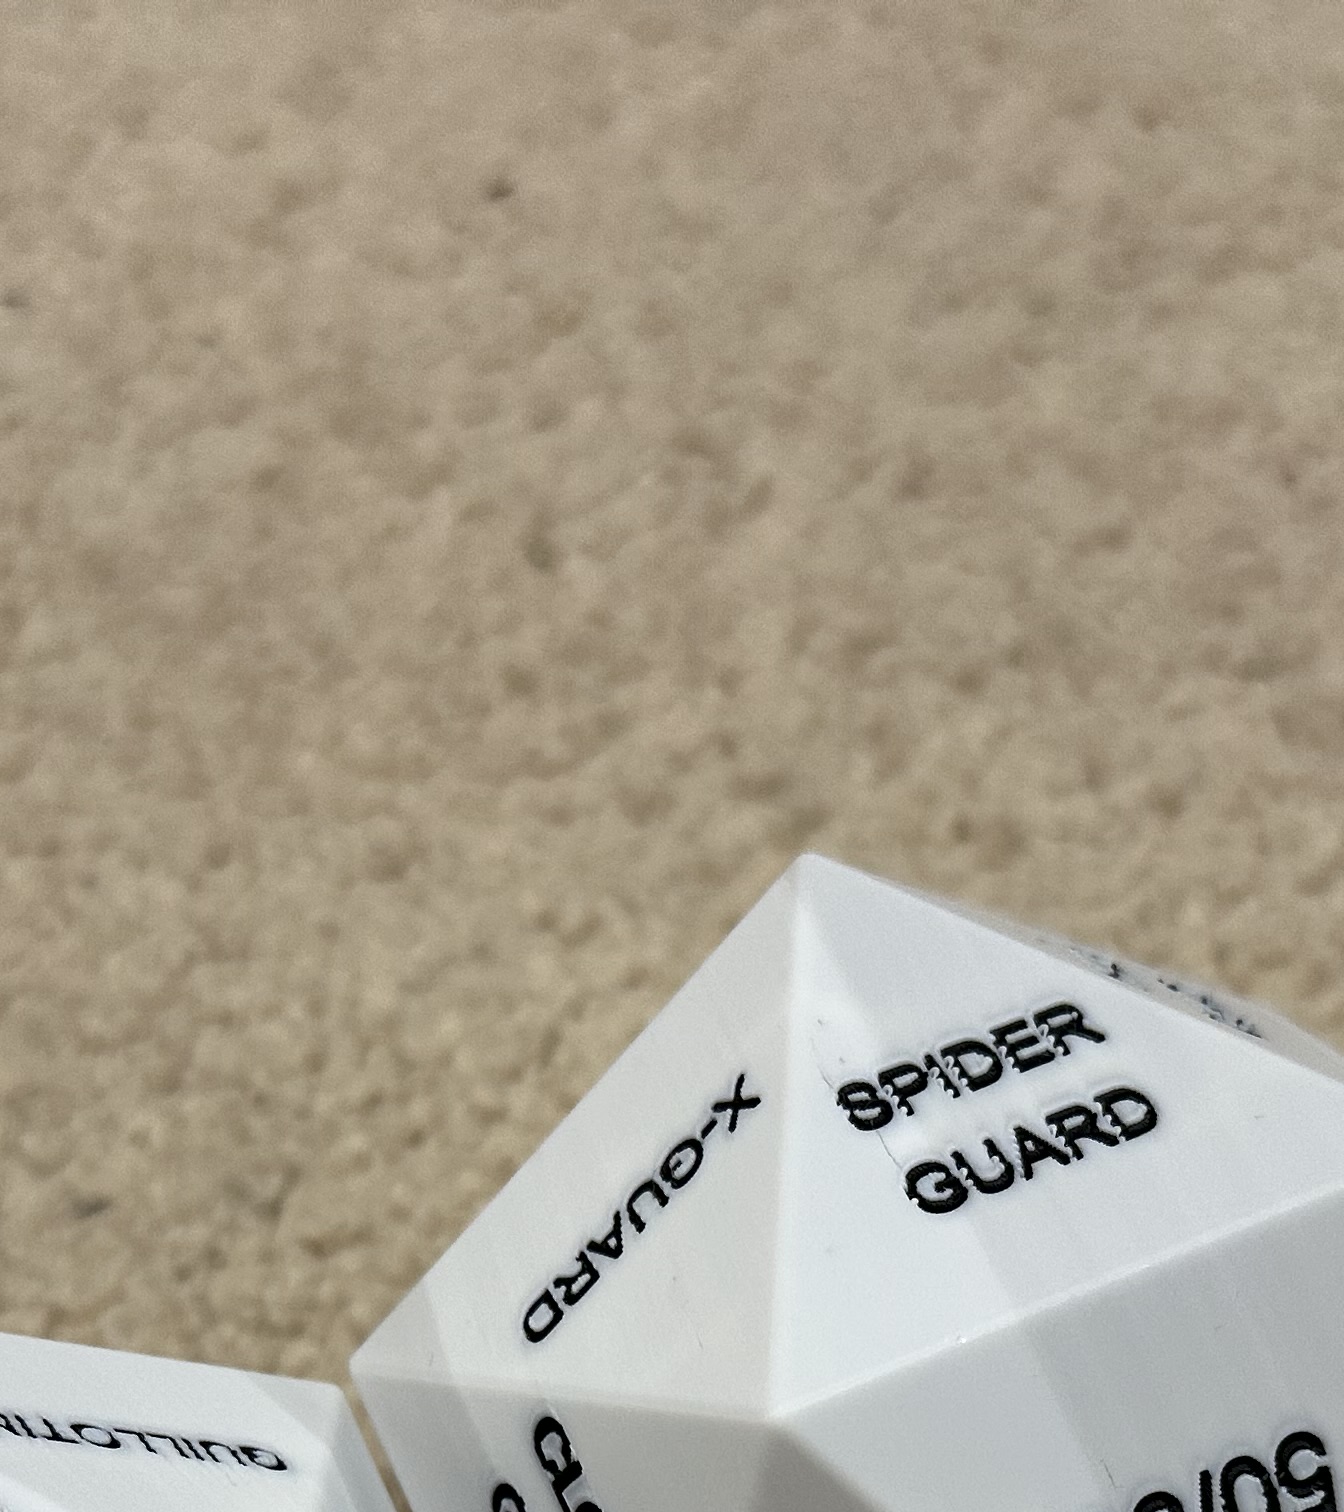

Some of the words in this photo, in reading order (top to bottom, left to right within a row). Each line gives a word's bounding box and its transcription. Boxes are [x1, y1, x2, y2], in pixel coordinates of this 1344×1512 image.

[837, 1003, 1106, 1132] SPIDER
[522, 1073, 762, 1344] X-GUARD
[904, 1087, 1158, 1215] GUARD
